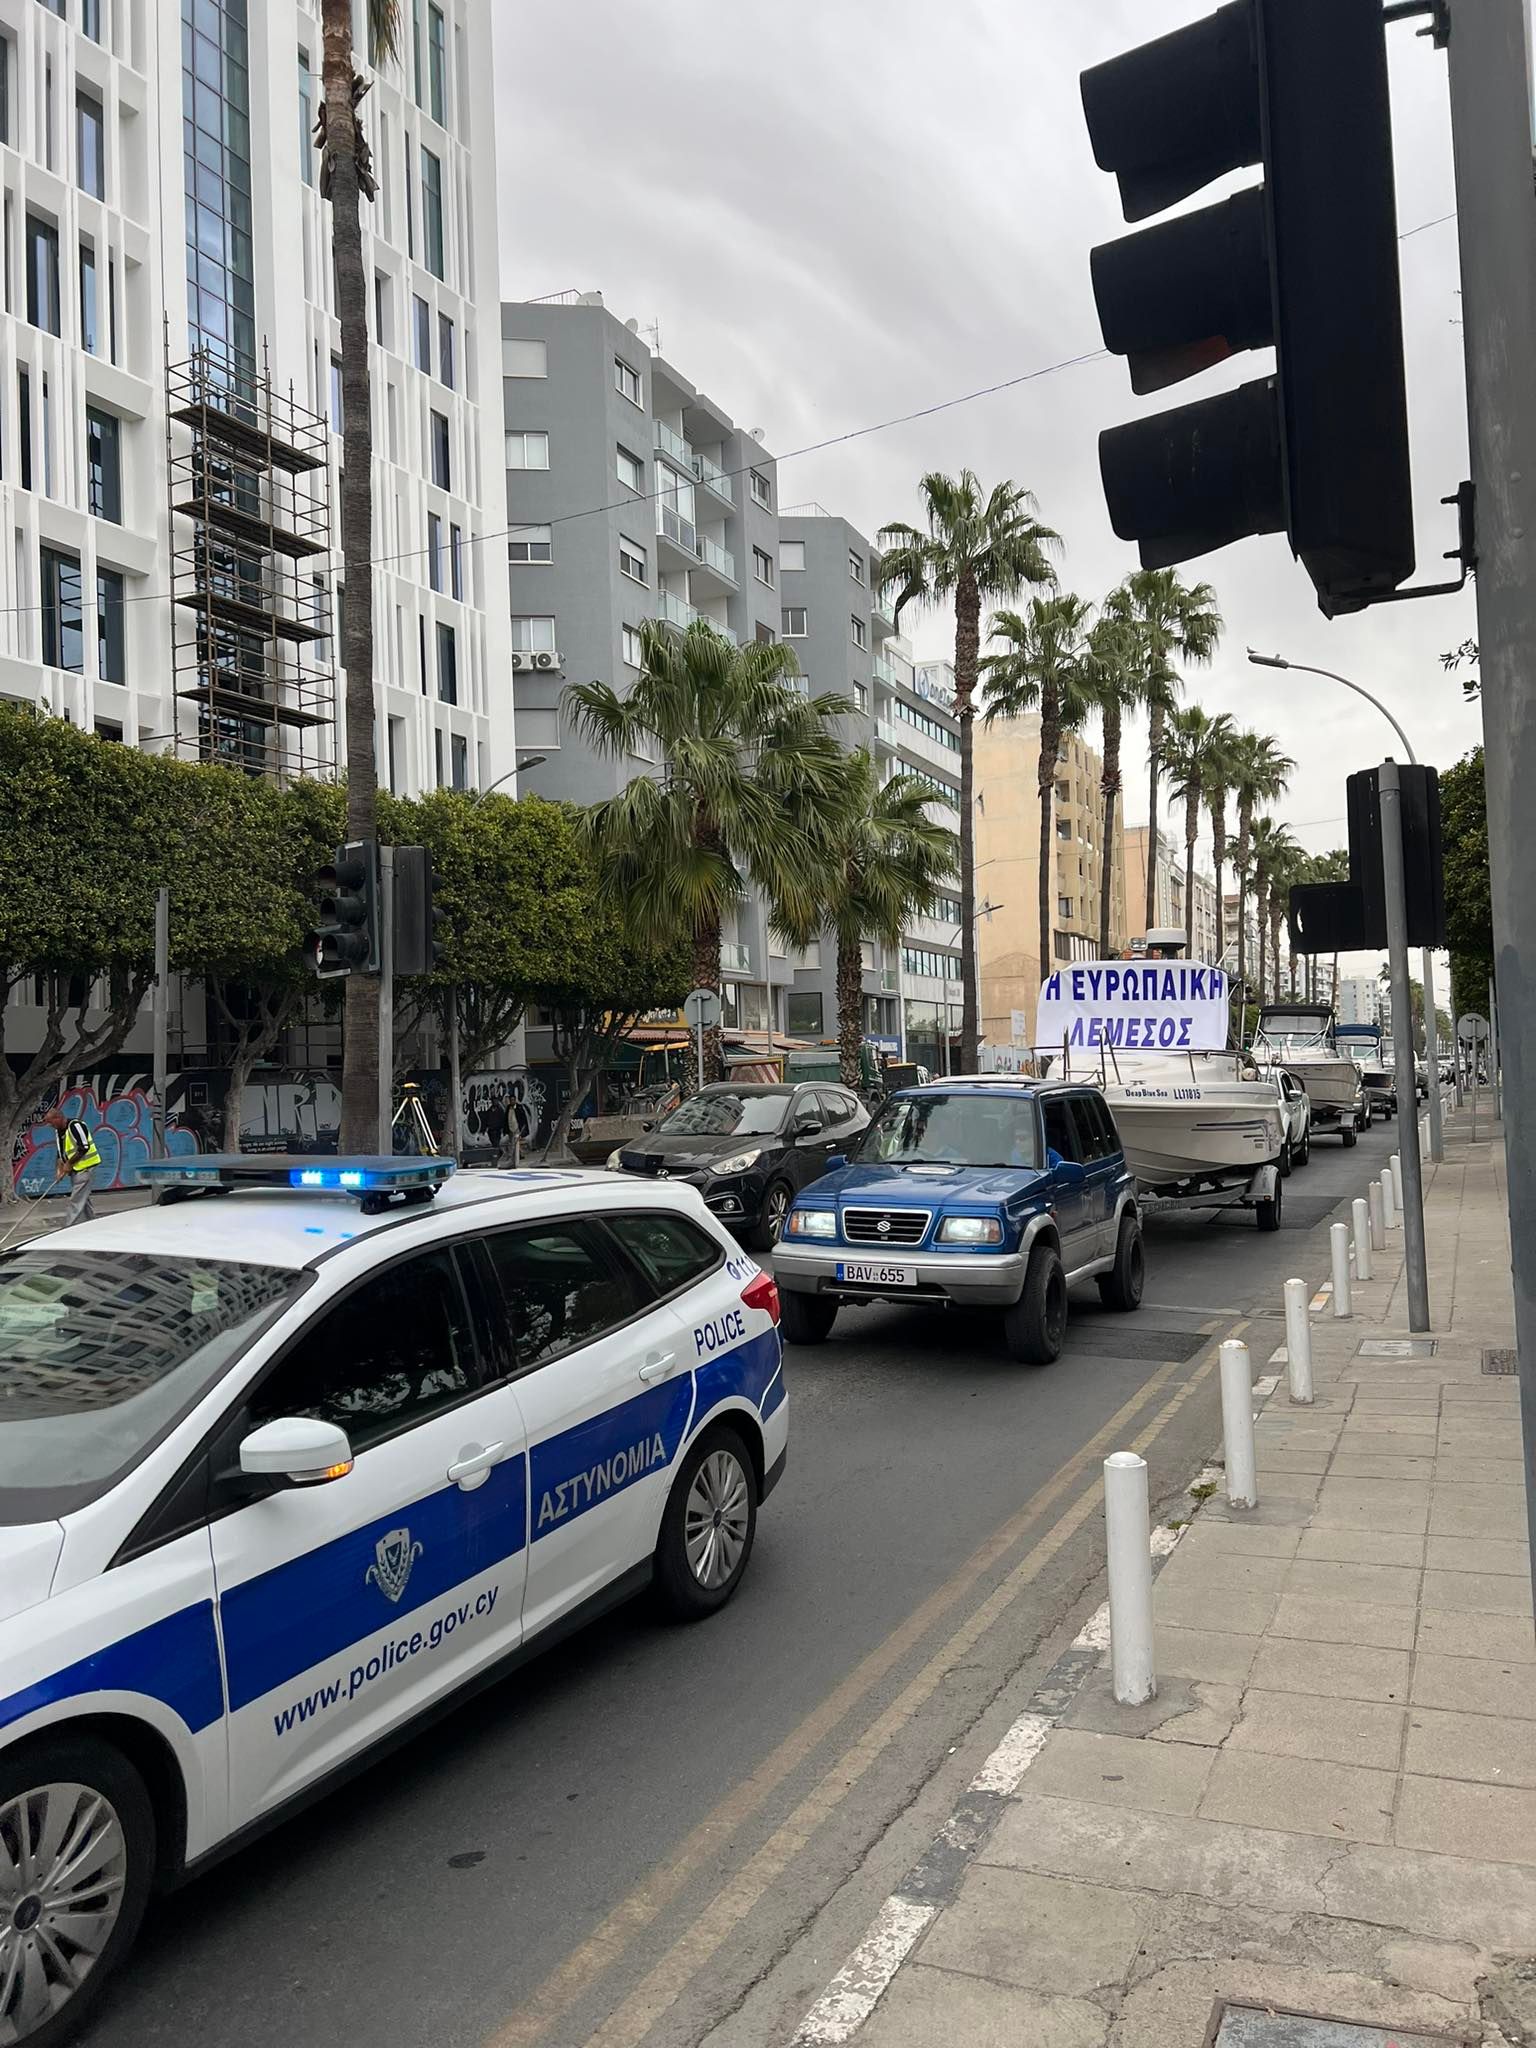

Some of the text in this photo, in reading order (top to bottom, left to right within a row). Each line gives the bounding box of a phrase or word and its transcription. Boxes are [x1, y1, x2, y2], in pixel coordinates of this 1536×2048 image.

[1046, 968, 1223, 1001] Η ΕΥΡΩΠΑΙΚΗ
[1070, 1017, 1193, 1047] ΛΕΜΕΣΟΣ
[1156, 1088, 1168, 1097] Sea
[847, 1265, 872, 1281] BAV
[880, 1268, 905, 1283] 655
[693, 1309, 746, 1356] POLICE
[537, 1432, 667, 1529] ΑΣΤΥΝΟΜΙΑ
[273, 1585, 500, 1737] www.police.gov.cy
